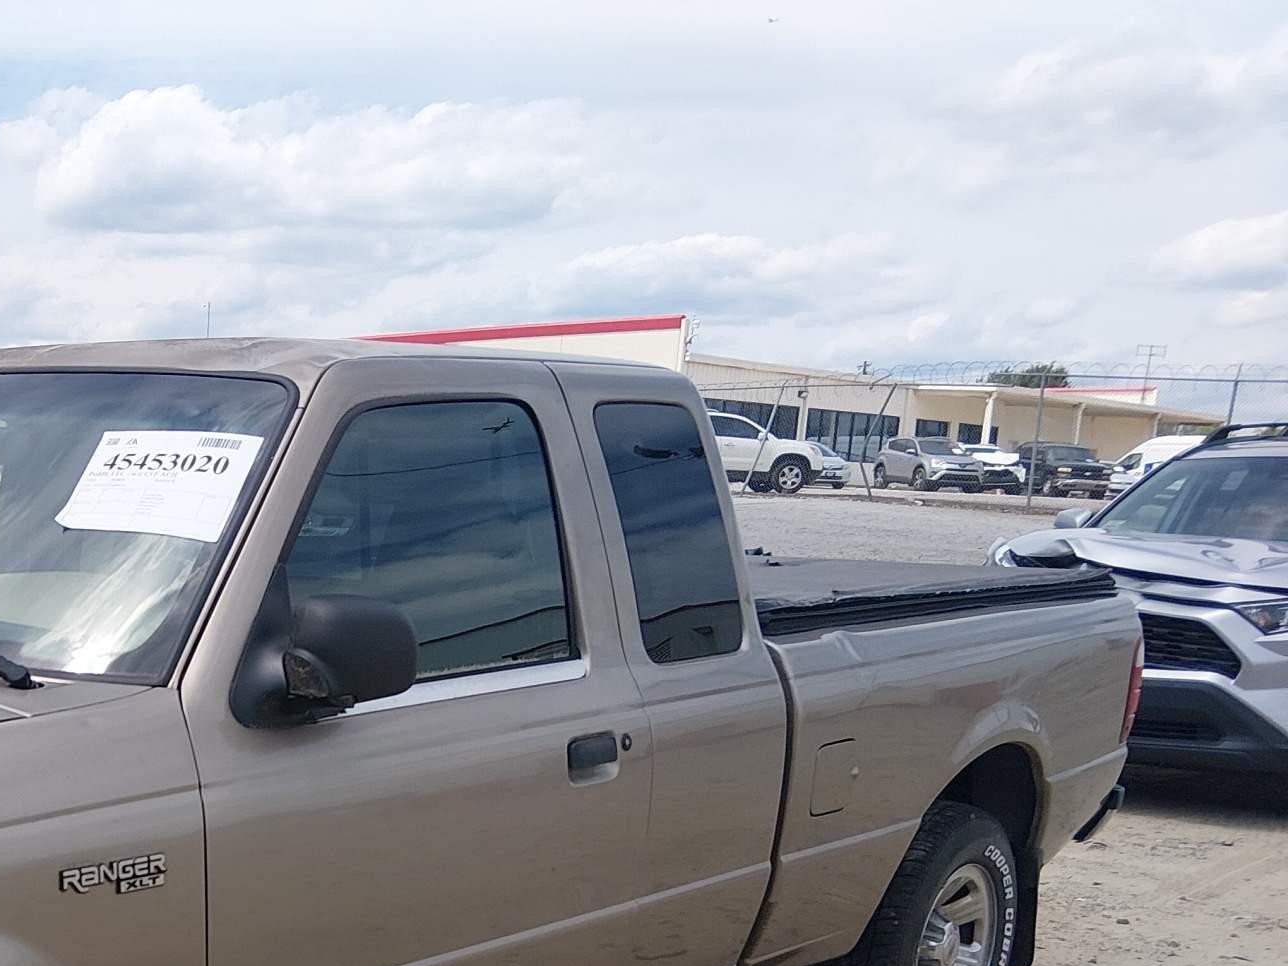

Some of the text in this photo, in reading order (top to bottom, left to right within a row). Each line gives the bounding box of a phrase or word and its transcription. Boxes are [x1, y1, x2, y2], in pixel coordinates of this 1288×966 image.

[104, 453, 230, 475] 45453020
[126, 876, 160, 890] XLT
[984, 845, 1013, 899] COOPER
